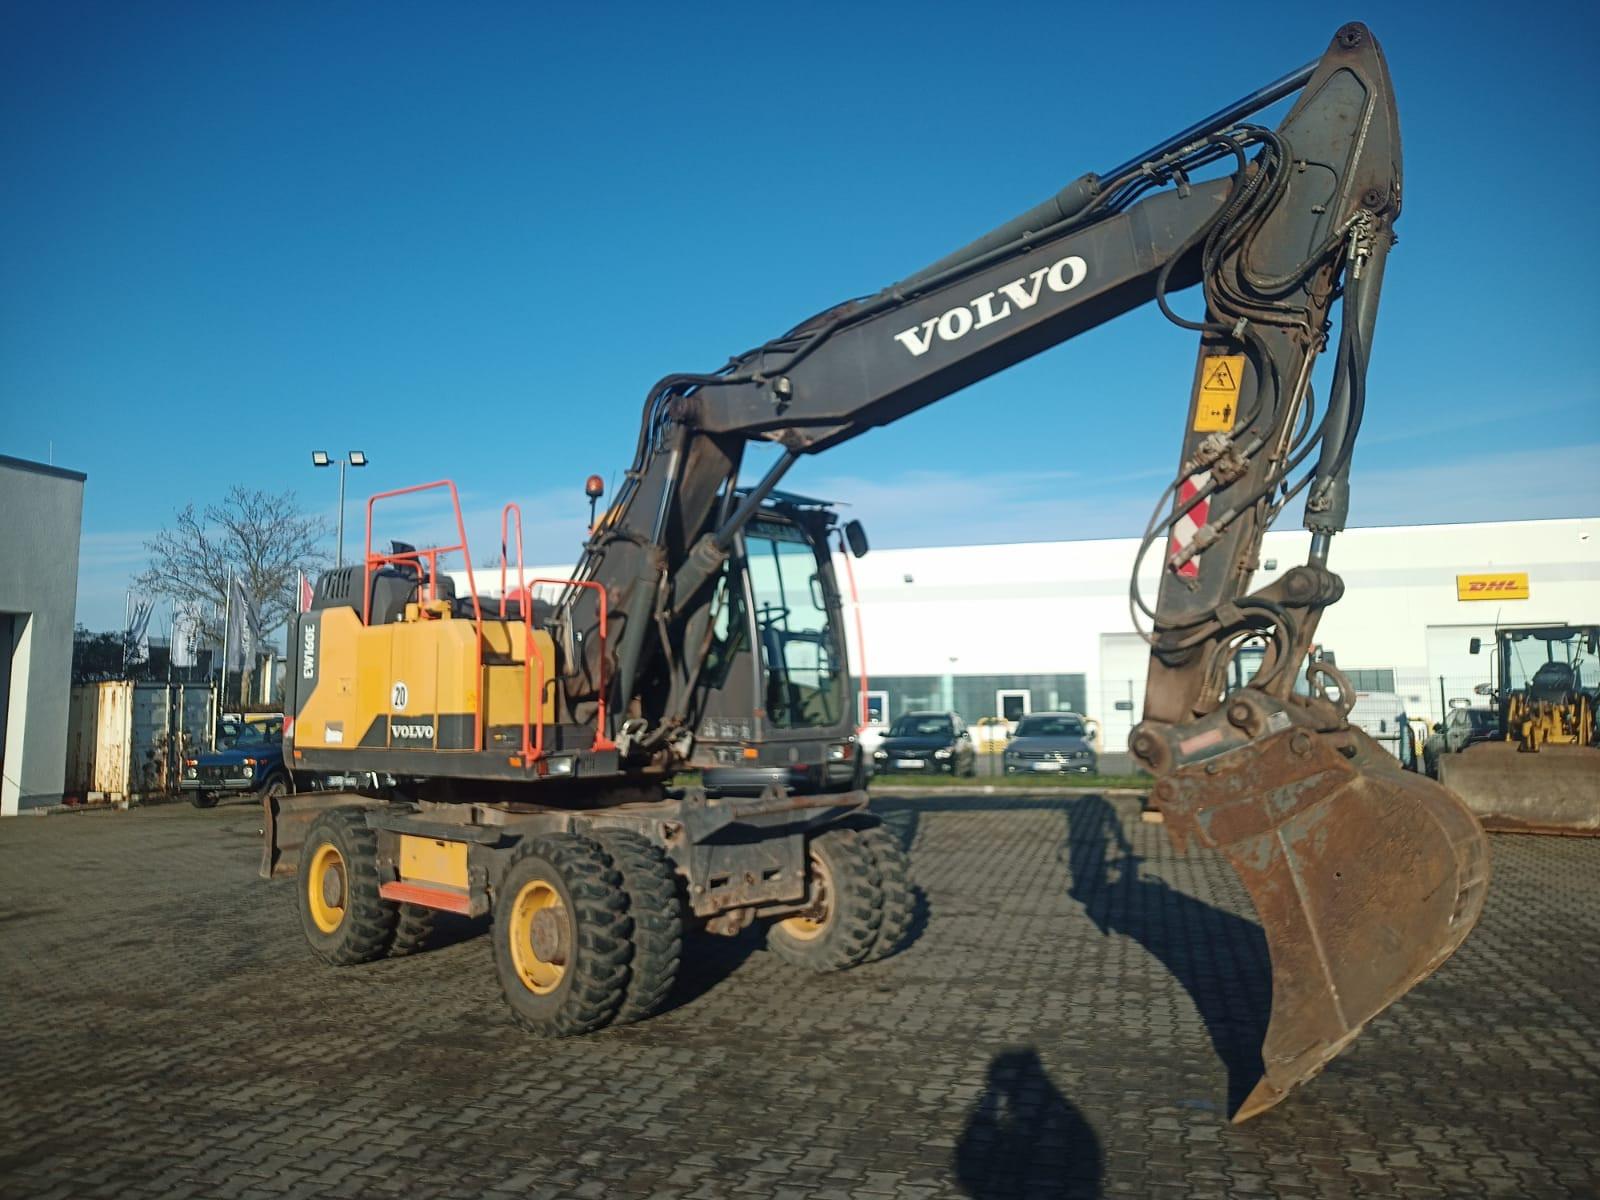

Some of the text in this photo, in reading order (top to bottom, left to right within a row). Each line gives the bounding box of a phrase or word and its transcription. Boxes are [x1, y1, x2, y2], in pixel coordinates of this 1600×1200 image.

[894, 256, 1087, 356] VOLVO
[1469, 581, 1519, 591] DHL
[303, 624, 315, 679] EW160E
[394, 686, 406, 706] 20
[392, 725, 434, 738] VOLVO
